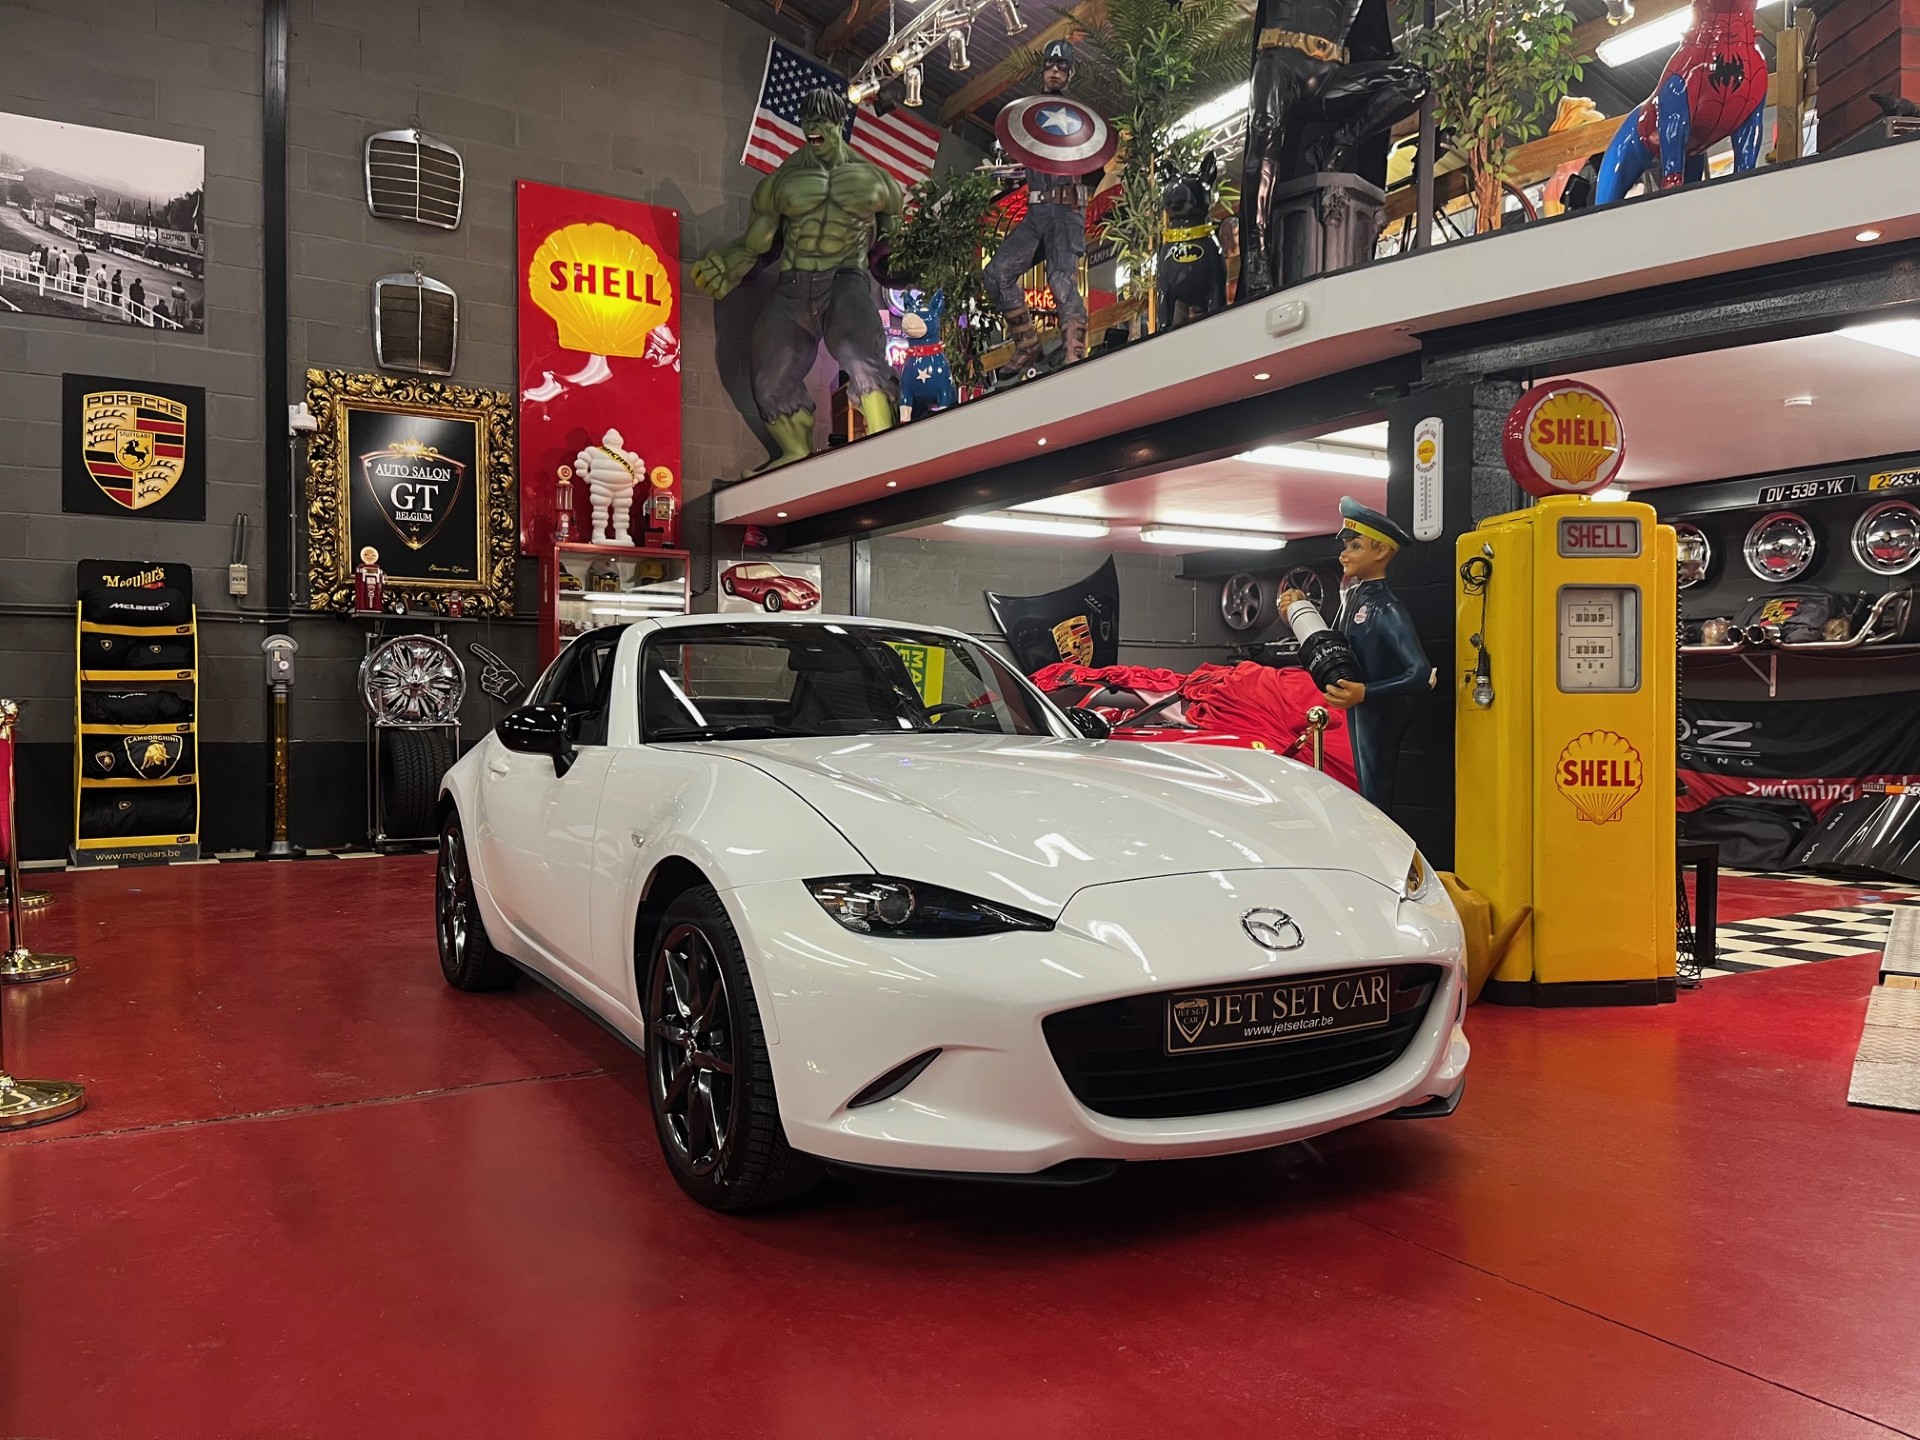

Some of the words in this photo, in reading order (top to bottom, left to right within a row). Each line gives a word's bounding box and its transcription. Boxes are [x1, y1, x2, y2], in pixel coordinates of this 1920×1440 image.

[1050, 44, 1062, 57] A
[550, 260, 661, 307] SHELL
[87, 395, 183, 418] PORSCHE
[119, 431, 152, 440] STUTTGART
[1537, 418, 1612, 447] SHELL
[375, 463, 410, 477] AUTO
[412, 466, 451, 480] SALON
[390, 482, 439, 511] GT
[395, 511, 433, 522] BELGIUM
[1567, 525, 1628, 548] SHELL
[109, 602, 165, 611] McLaren
[128, 734, 179, 744] LAMBORGHINI
[1563, 760, 1636, 787] SHELL
[95, 849, 181, 861] www.meguiars.be
[1209, 992, 1264, 1027] JET
[1272, 983, 1326, 1020] SET
[1332, 975, 1388, 1010] CAR
[1177, 1008, 1190, 1017] JET
[1191, 1007, 1205, 1016] SET
[1183, 1016, 1199, 1025] CAR
[1243, 1014, 1334, 1037] www.jetsetcar.be
